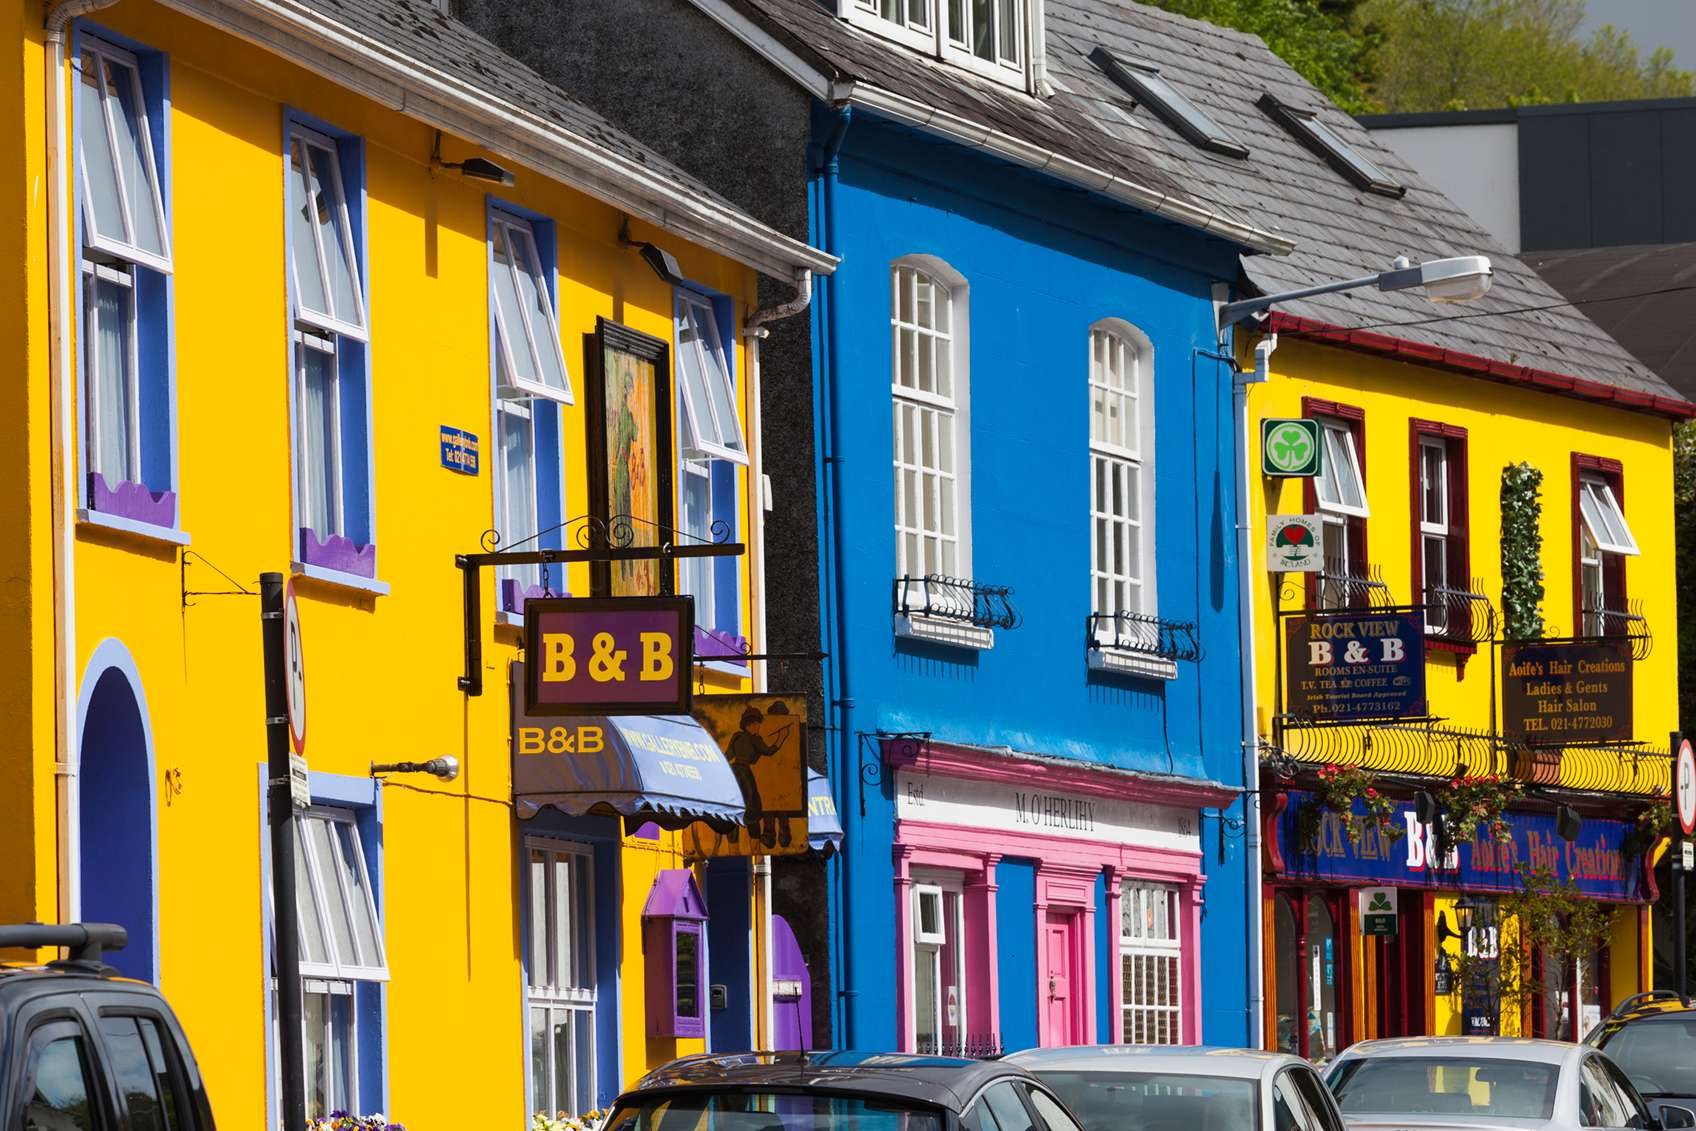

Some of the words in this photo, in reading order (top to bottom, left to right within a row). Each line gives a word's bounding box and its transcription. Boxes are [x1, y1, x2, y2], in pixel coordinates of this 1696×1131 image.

[1310, 622, 1355, 639] ROCK
[1358, 621, 1399, 637] VIEW
[542, 633, 576, 682] B
[588, 632, 627, 682] &
[640, 631, 674, 681] B
[1308, 641, 1333, 665] B
[1344, 640, 1369, 663] &
[1380, 638, 1404, 661] B
[1315, 667, 1350, 677] ROOMS
[1508, 661, 1544, 676] Aoife's
[1550, 660, 1572, 675] Hair
[1578, 658, 1625, 674] Creations
[1320, 679, 1337, 689] TEA
[1354, 678, 1388, 688] COFFEE
[1526, 682, 1561, 696] Ladies
[1565, 684, 1572, 695] &
[1576, 680, 1608, 694] Gents
[1538, 700, 1563, 713] Hair
[1566, 699, 1597, 712] Salon
[518, 726, 604, 754] B&B
[1527, 830, 1560, 878] Hair
